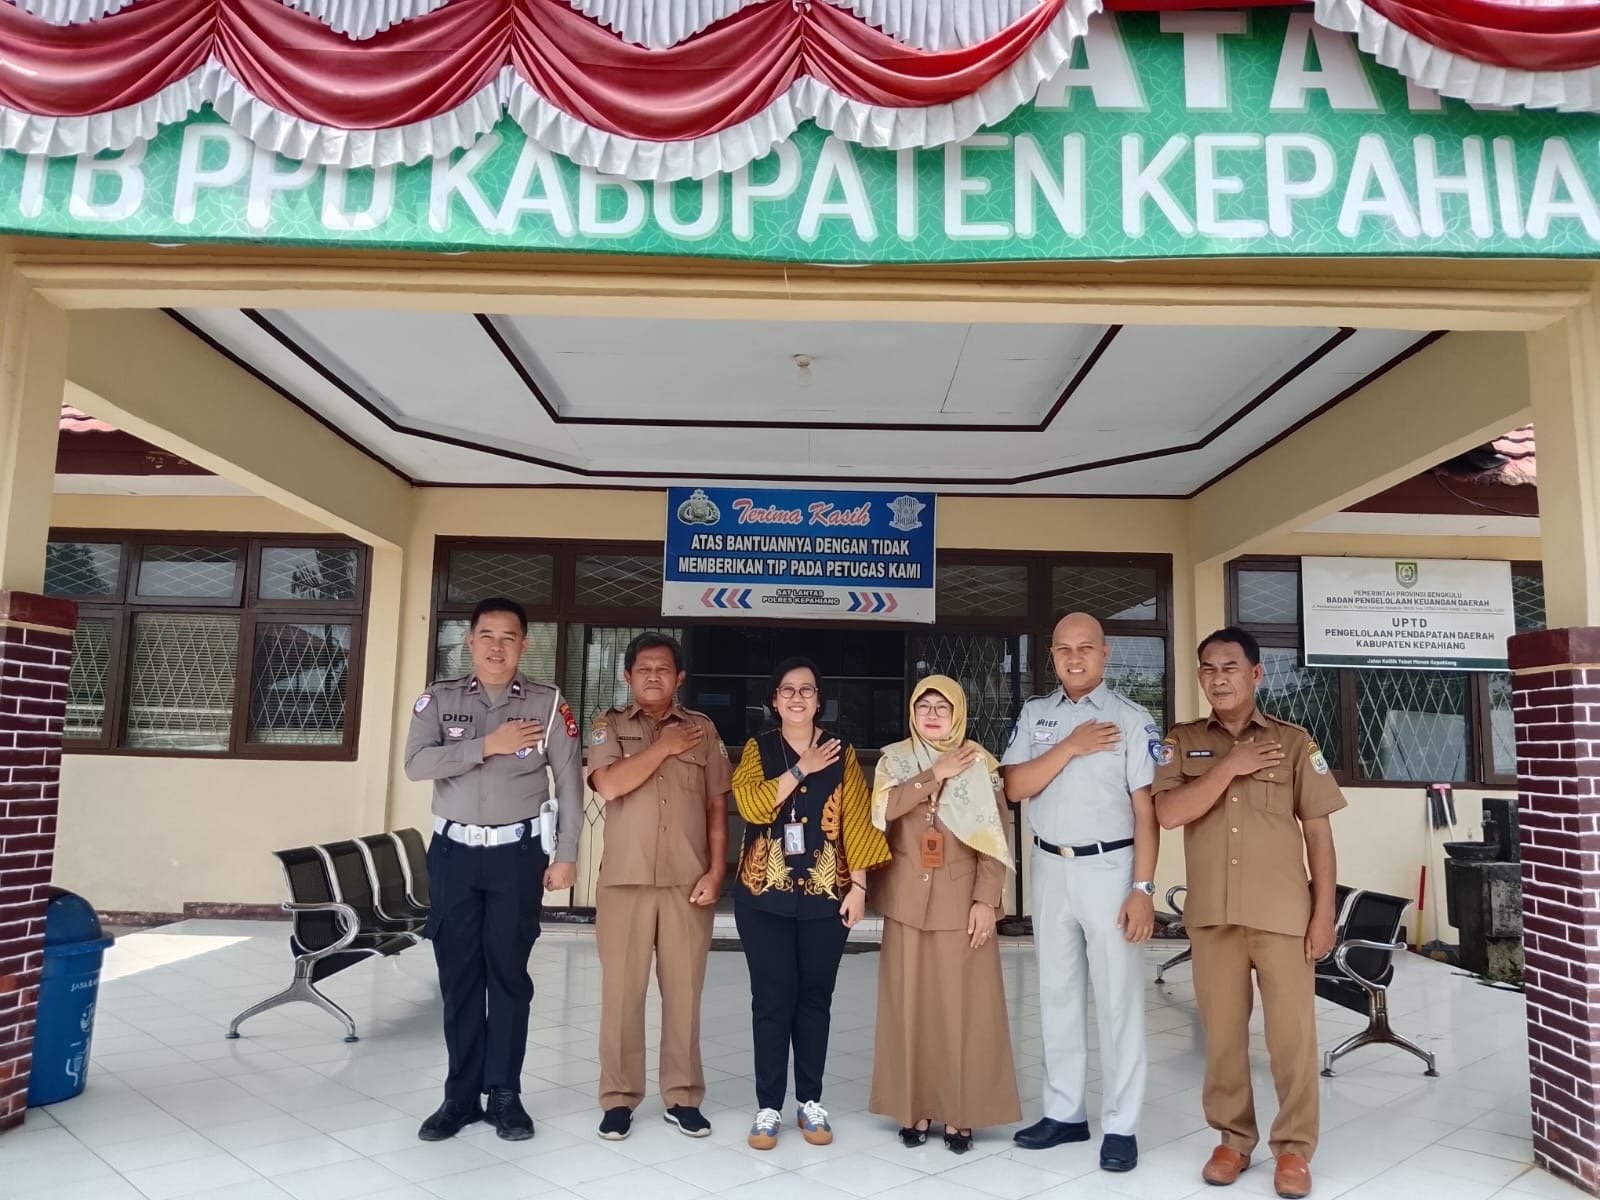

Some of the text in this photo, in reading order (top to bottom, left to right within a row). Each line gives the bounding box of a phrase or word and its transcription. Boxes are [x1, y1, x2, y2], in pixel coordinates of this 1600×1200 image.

[1034, 10, 1516, 112] ATA
[427, 130, 1088, 242] KABUPATEN
[732, 498, 871, 526] Terima Kasih
[691, 534, 910, 556] ATAS BANTUANNYA DENGAN TIDAK
[678, 557, 921, 579] MEMBERIKAN TIP PADA PETUGAS KAMI
[793, 589, 824, 598] LANTAS
[1427, 591, 1462, 599] BENGKULU
[762, 596, 793, 604] POLRES
[1326, 596, 1490, 607] BADAN PENGELOLAAN KEUANGAN DAERAH
[1392, 617, 1428, 628] UPTD
[1325, 628, 1495, 640] PENGELOLAAN PENDAPATAN DAERAH
[1356, 639, 1466, 650] KABUPATEN KEPAHIANG
[442, 713, 474, 723] DIDI
[1035, 718, 1059, 727] ARIEF
